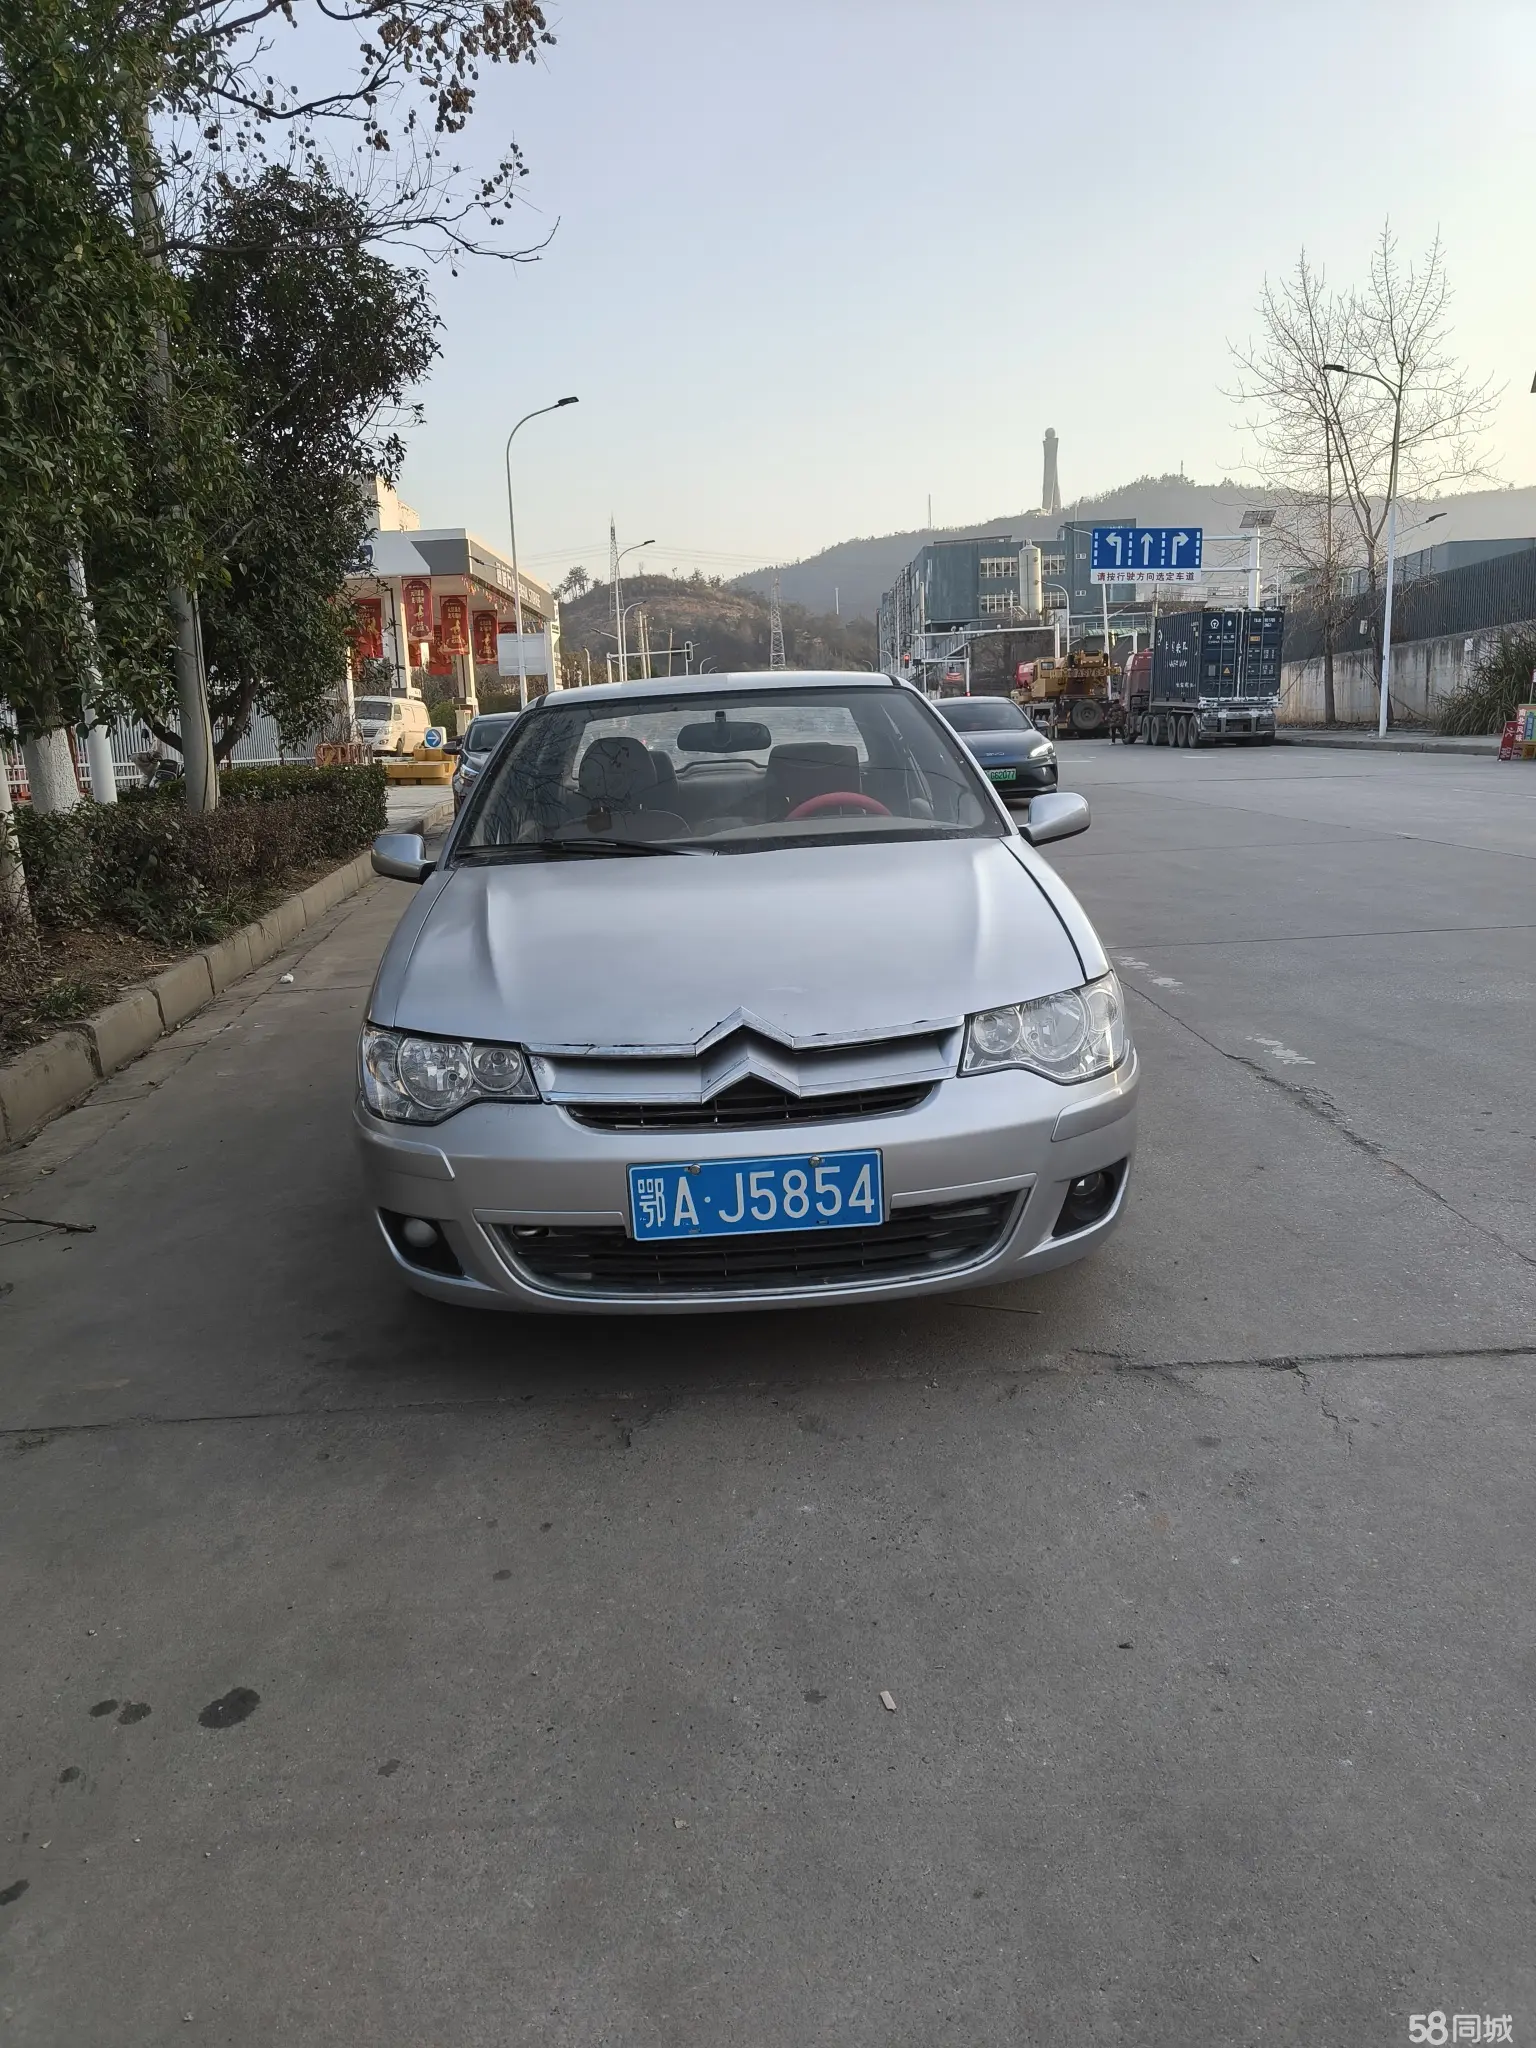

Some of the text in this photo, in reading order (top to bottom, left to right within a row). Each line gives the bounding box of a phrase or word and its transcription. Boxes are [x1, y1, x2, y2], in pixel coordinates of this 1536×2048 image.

[1097, 571, 1195, 581] 请按行驶方向选定车道
[637, 1163, 875, 1228] 鄂A·J5854
